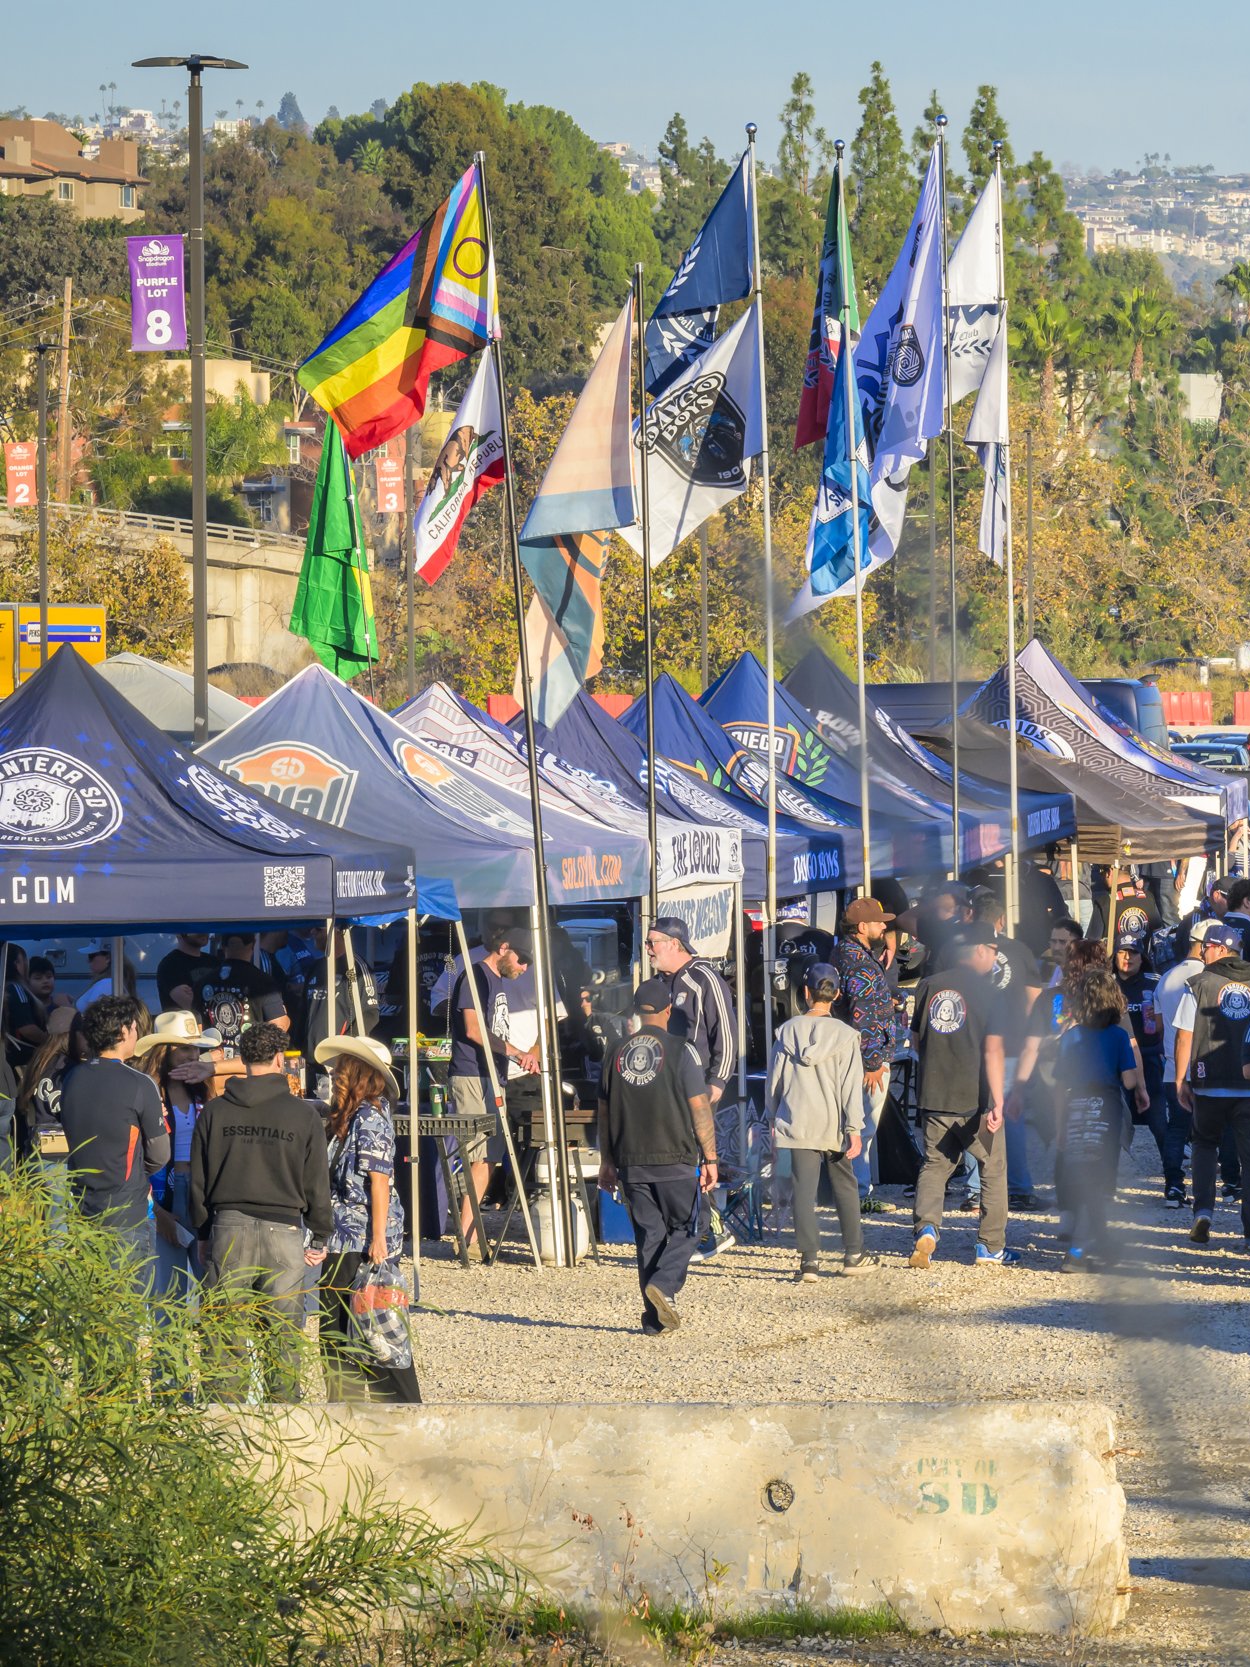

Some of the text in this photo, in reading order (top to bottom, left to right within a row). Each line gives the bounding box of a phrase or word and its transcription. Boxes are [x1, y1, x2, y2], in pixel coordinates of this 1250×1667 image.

[136, 277, 178, 287] PURPLE
[147, 289, 168, 298] LOT
[146, 309, 172, 345] 8
[637, 376, 720, 452] DAYGO
[662, 395, 715, 442] BOYS
[15, 483, 29, 503] 2
[385, 493, 398, 510] 3
[428, 482, 468, 540] CALIFORNIA
[29, 628, 41, 638] PENS
[731, 730, 785, 754] DIEGO
[269, 757, 306, 779] SD
[81, 764, 108, 809] SD
[671, 833, 688, 878] THE
[793, 850, 840, 884] DAYGO BOYS
[1224, 982, 1249, 995] CHAVOS
[1126, 1004, 1142, 1012] ECT
[1221, 1005, 1250, 1019] SAN DIEGO
[941, 1021, 960, 1033] DIEGO
[628, 1036, 657, 1049] CHAVOS
[621, 1069, 657, 1086] SAN DIEGO
[222, 1125, 295, 1143] ESSENTIALS
[915, 1481, 999, 1516] SD
